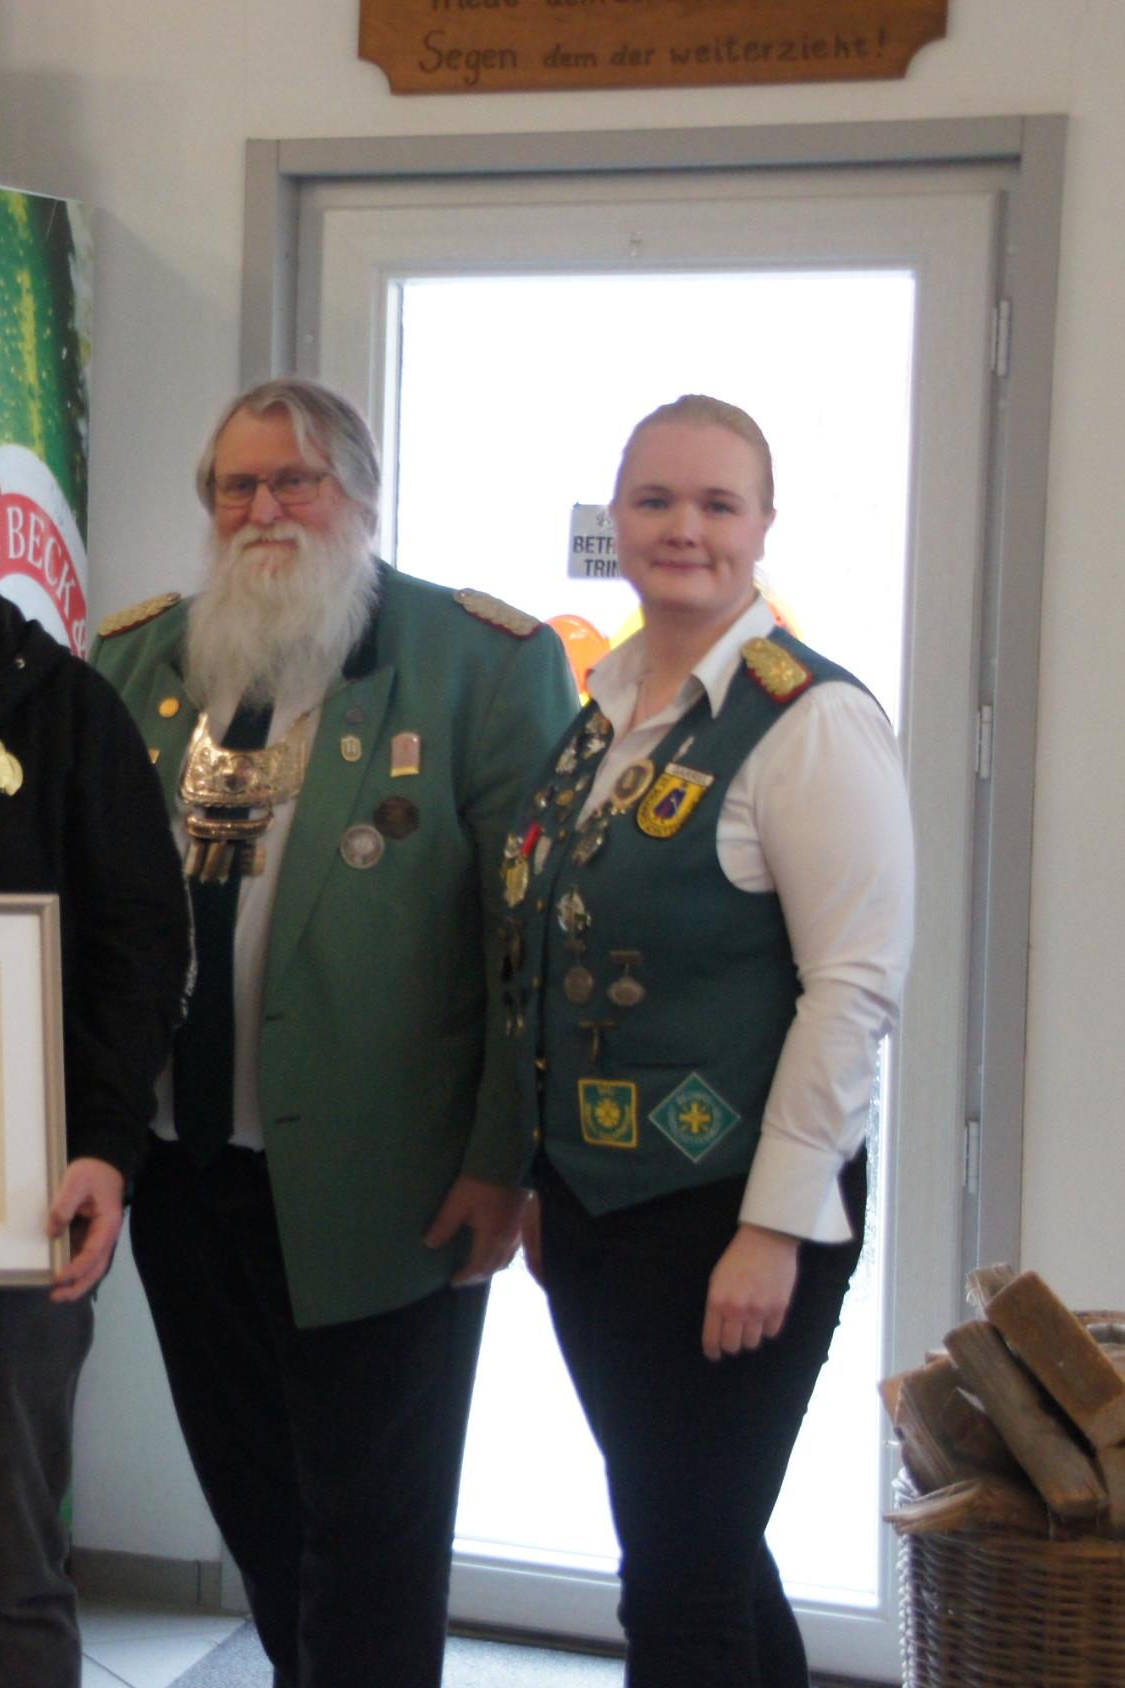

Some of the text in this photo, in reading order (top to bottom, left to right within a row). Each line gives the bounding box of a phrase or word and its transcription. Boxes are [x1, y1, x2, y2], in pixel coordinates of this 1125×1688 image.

[418, 28, 888, 86] Segen dem der weiterzieht!
[6, 505, 76, 621] BECK
